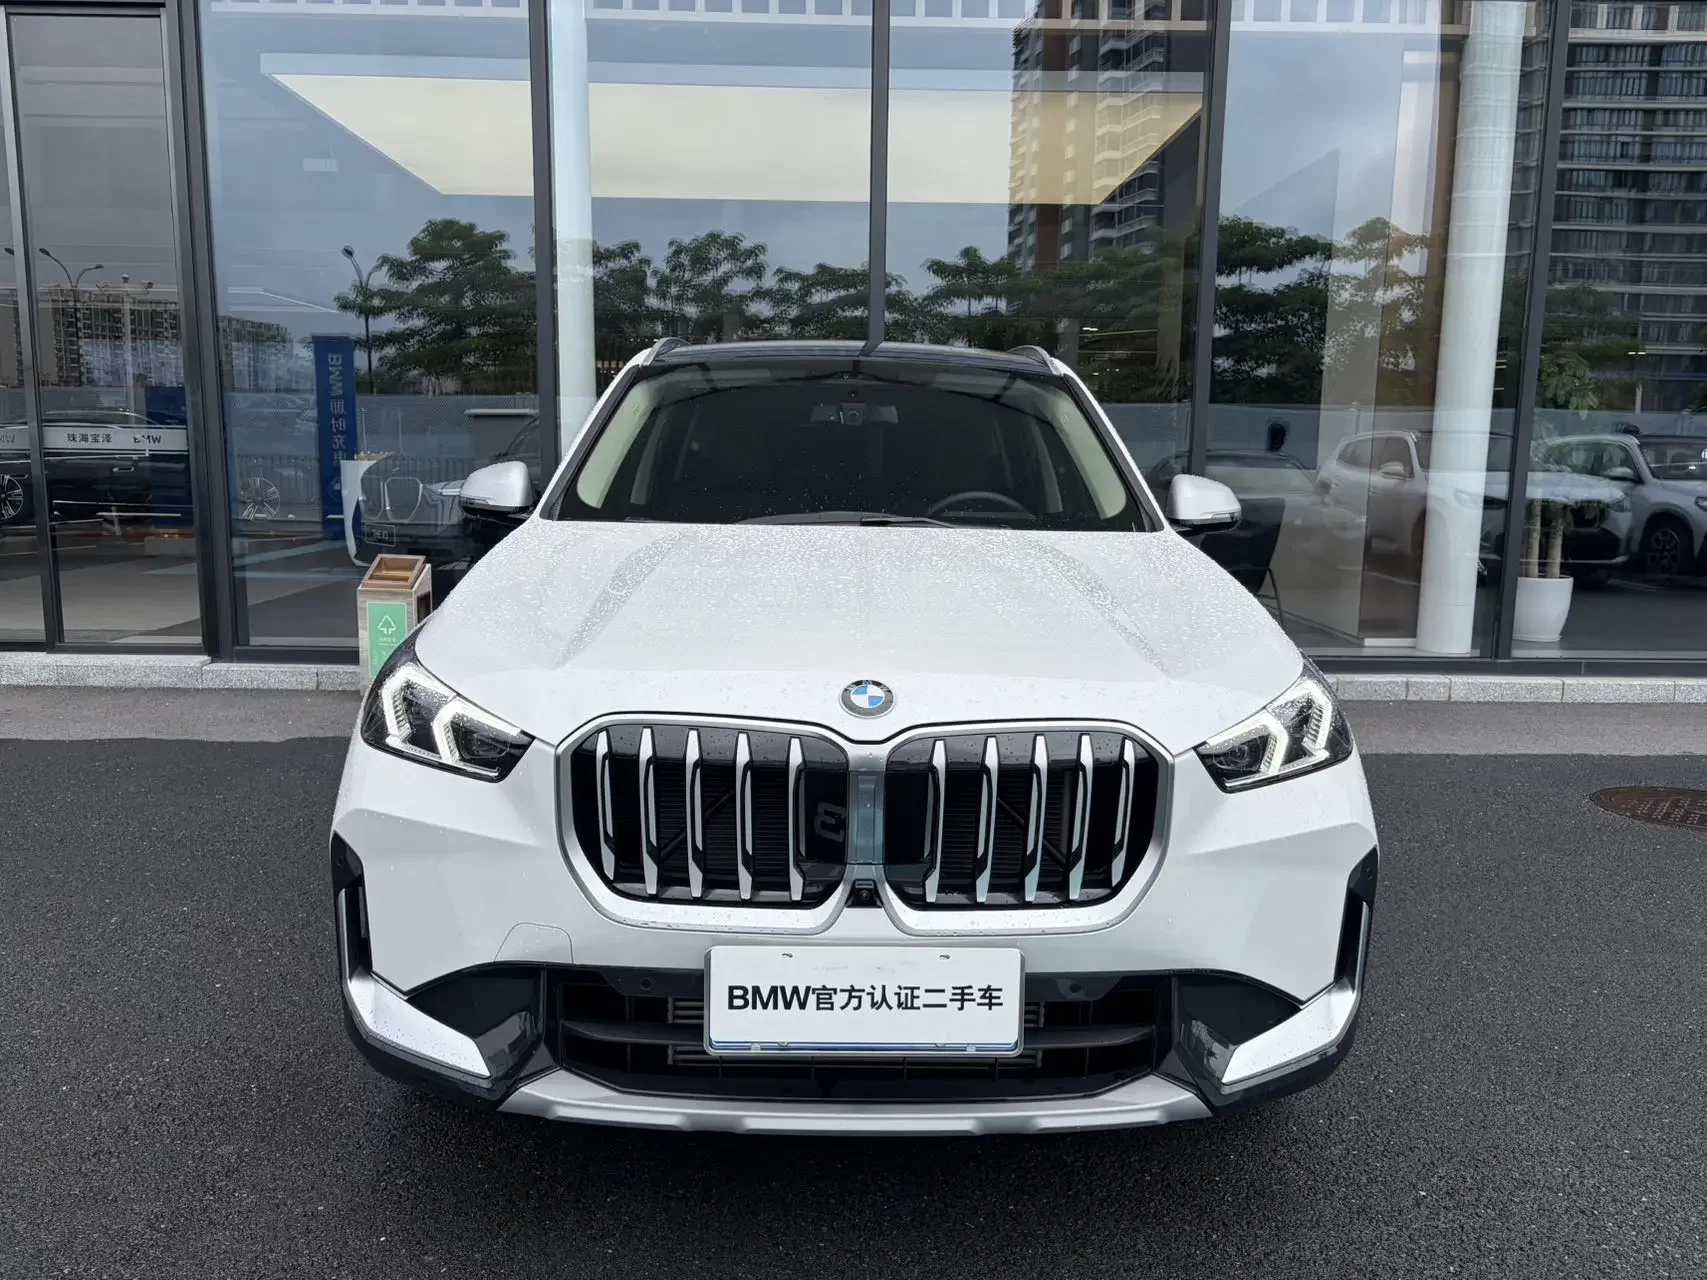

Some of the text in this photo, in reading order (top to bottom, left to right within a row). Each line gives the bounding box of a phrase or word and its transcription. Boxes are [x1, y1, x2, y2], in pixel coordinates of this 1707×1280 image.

[67, 432, 112, 443] 珠海宝泽
[727, 984, 1003, 1011] BMW官方认证二手车
